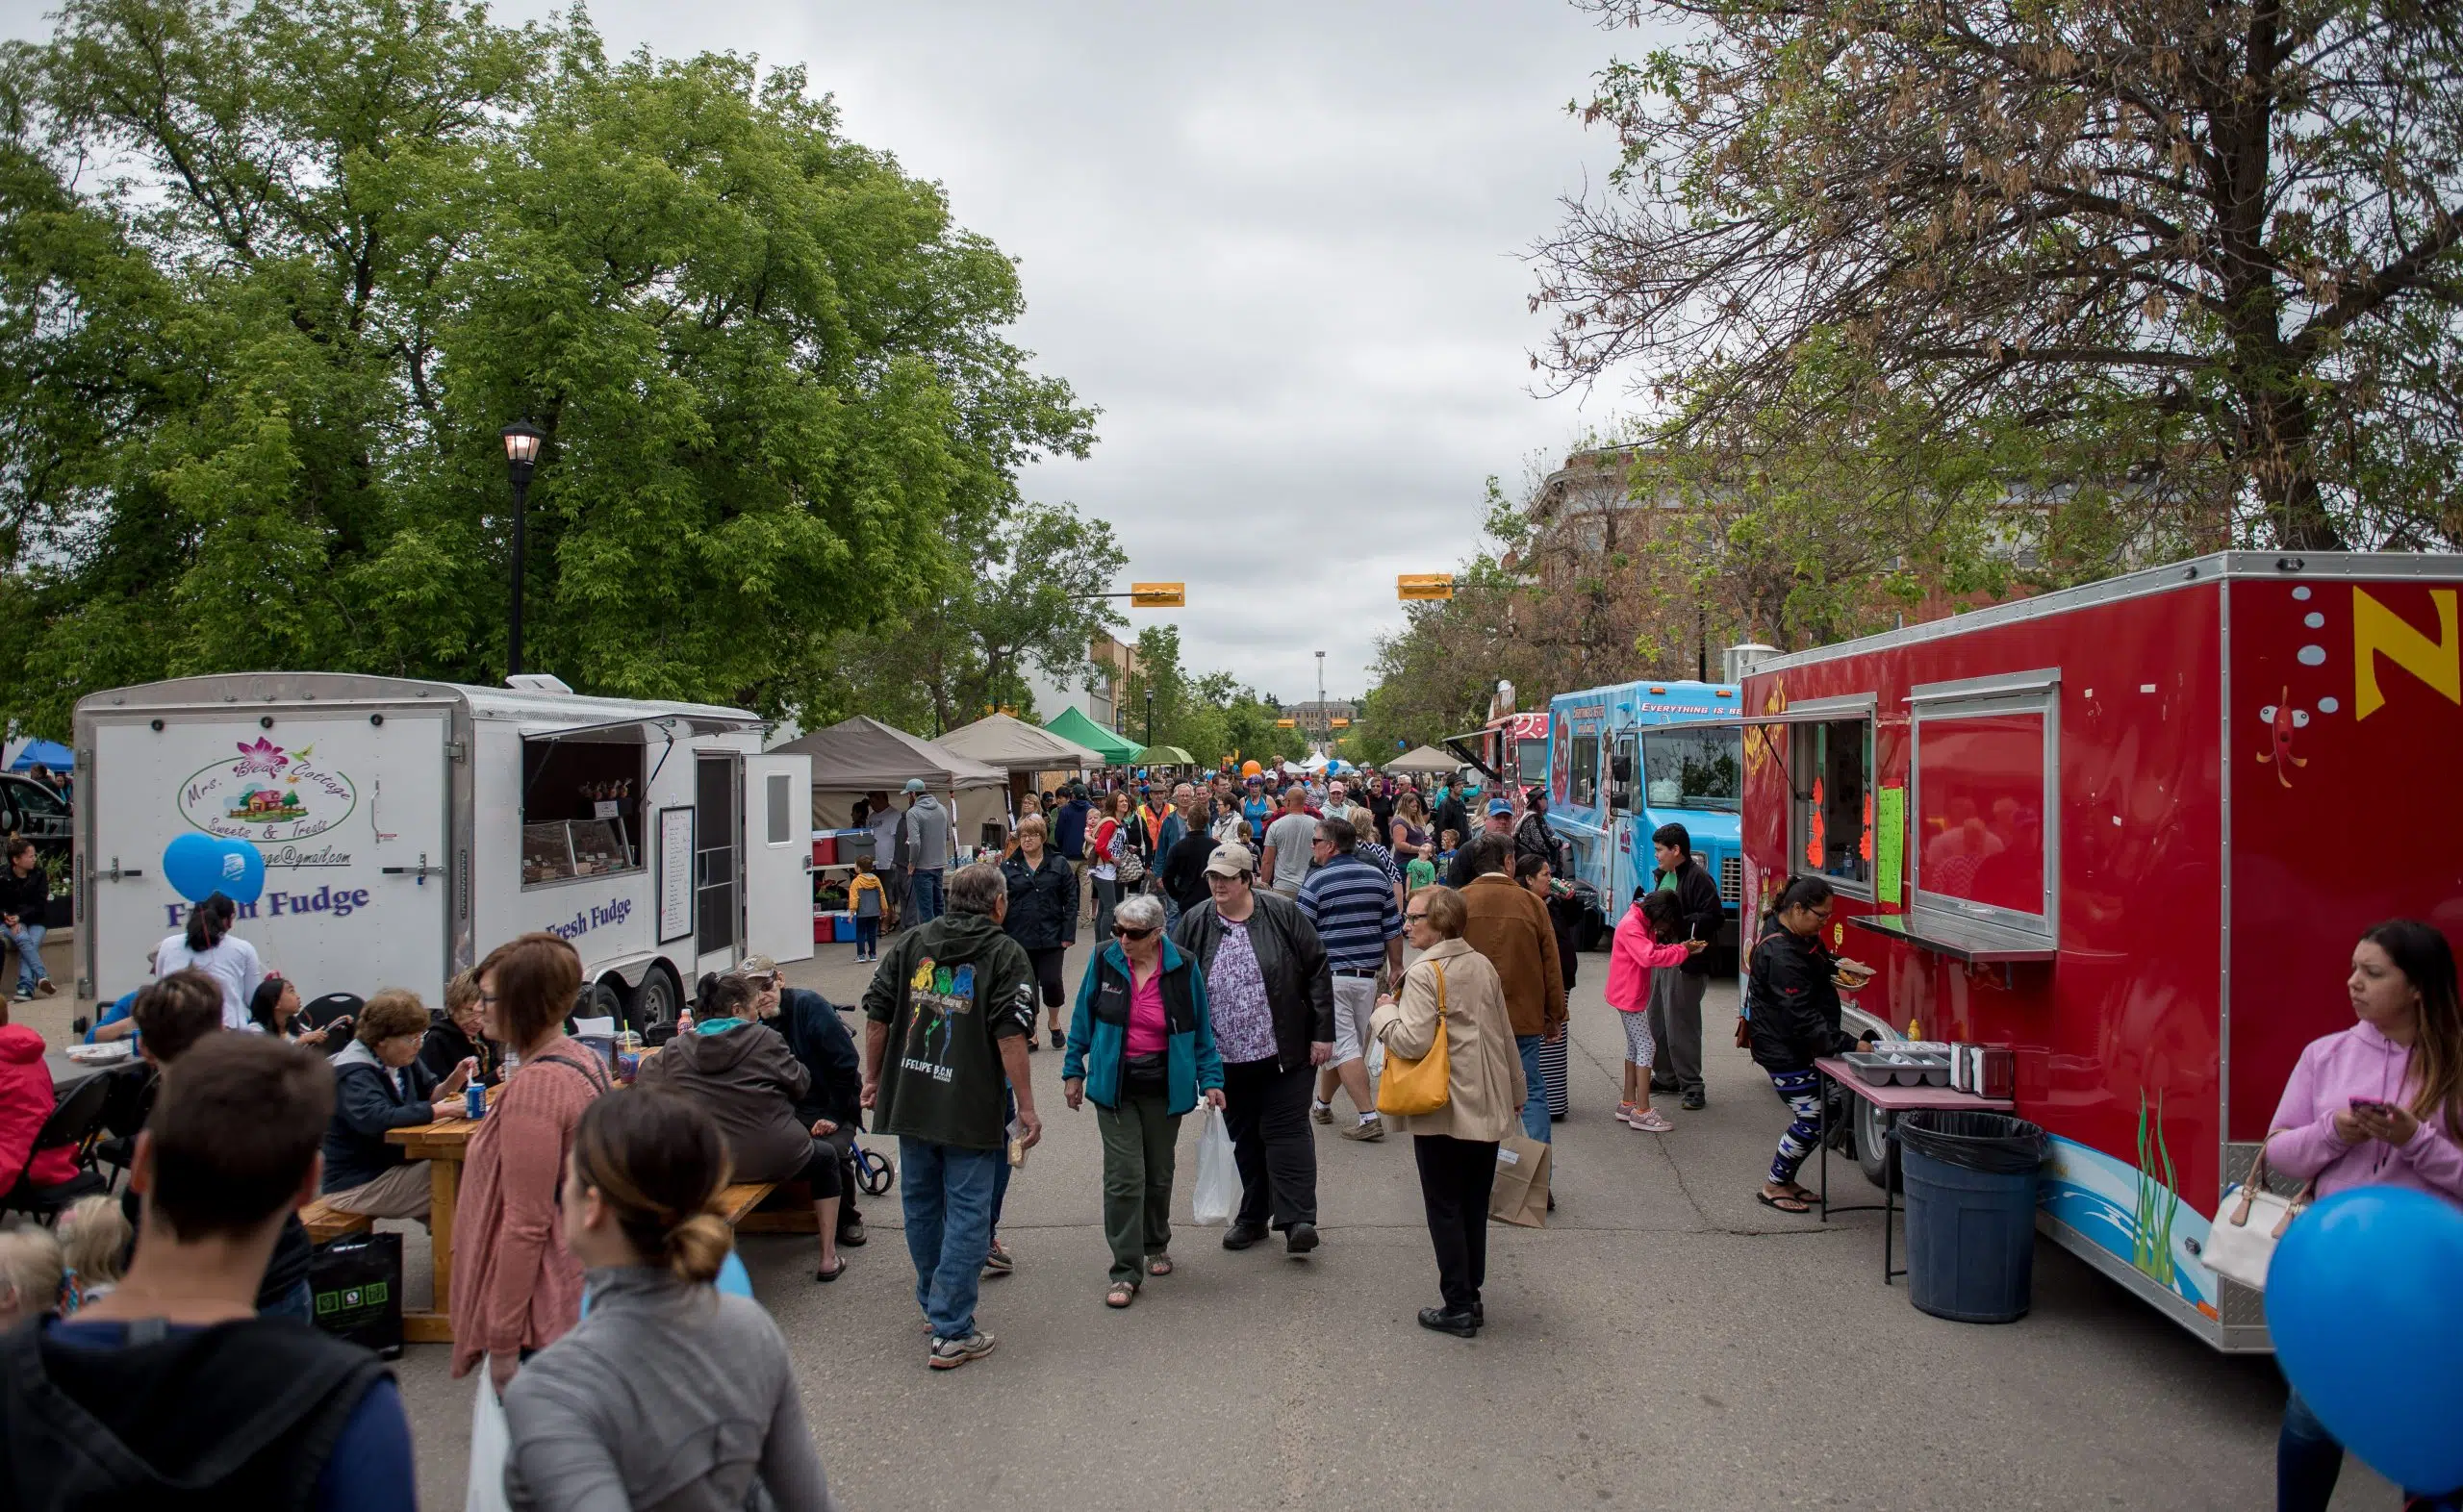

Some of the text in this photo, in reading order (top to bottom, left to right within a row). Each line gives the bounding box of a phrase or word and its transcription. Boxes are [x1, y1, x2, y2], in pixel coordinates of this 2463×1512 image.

[1640, 702, 1709, 714] EVERYTHING
[187, 759, 351, 809] Mrs. Bea's Cottage
[209, 818, 327, 840] Sweets & Treats
[268, 884, 369, 918] Fudge
[591, 897, 631, 929] Fudge
[905, 1058, 932, 1072] FELIPE
